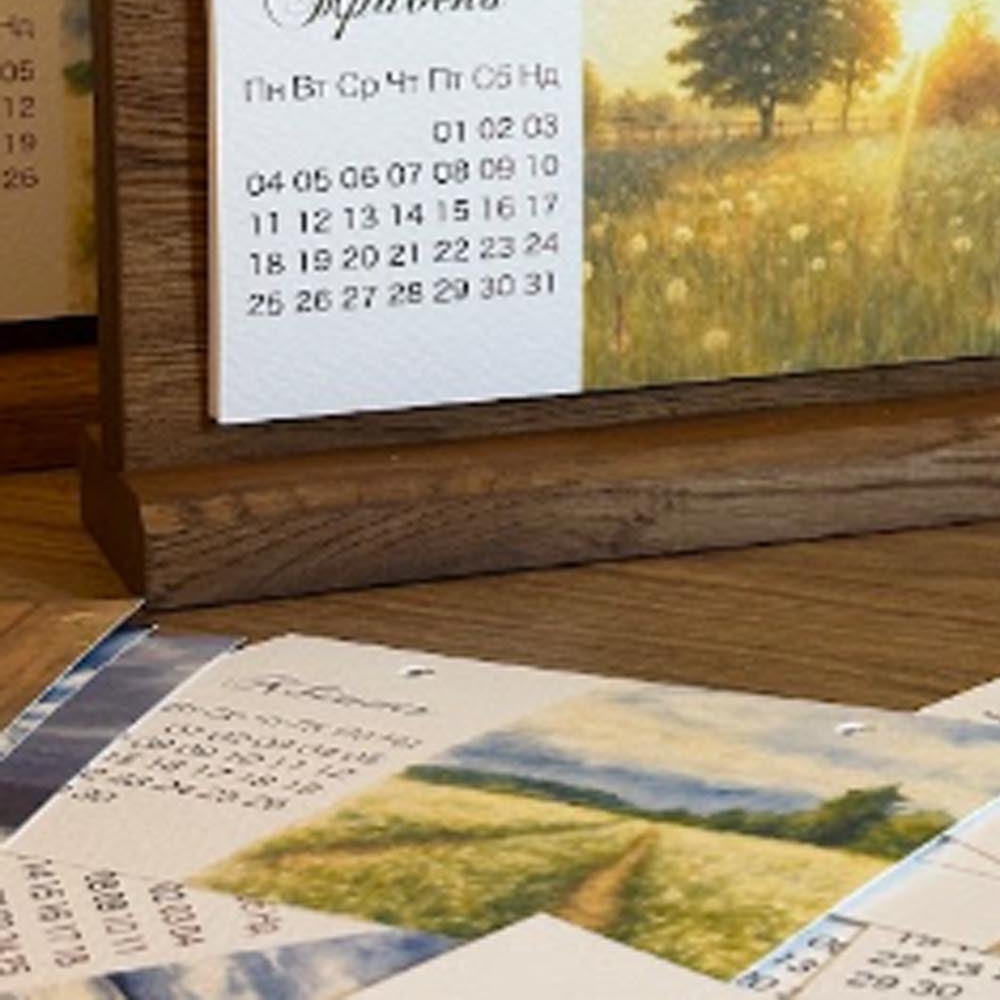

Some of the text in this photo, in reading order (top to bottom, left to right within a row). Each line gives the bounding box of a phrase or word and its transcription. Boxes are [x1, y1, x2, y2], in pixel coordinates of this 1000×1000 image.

[4, 96, 36, 119] 12
[433, 113, 558, 144] 01 02 03
[246, 154, 560, 197] 04 05 06 07 08 09 10
[252, 192, 558, 235] 11 12 13 14 15 16 17
[250, 232, 559, 275] 18 19 20 21 22 23 24
[247, 271, 554, 316] 25 26 27 28 29 30 31
[868, 949, 922, 969] 22
[930, 957, 985, 977] 23
[846, 968, 963, 999] 29 30
